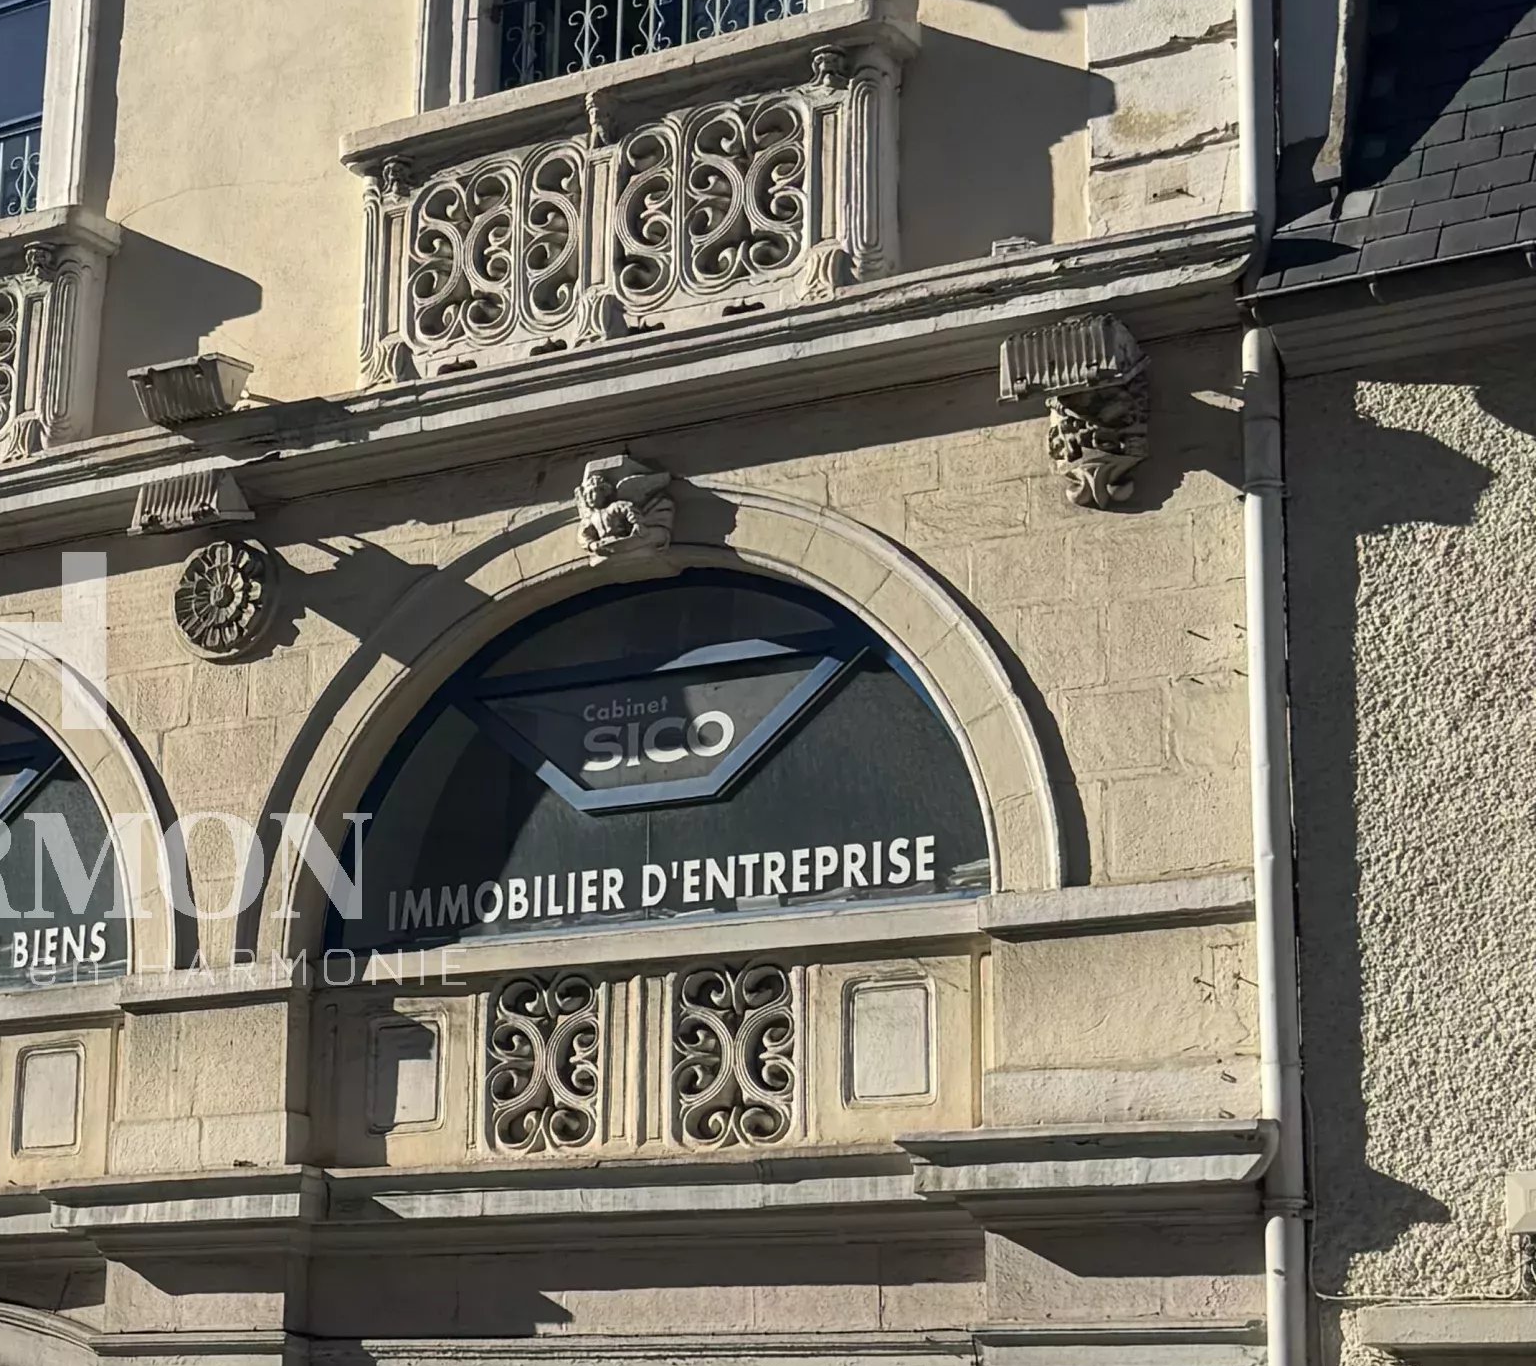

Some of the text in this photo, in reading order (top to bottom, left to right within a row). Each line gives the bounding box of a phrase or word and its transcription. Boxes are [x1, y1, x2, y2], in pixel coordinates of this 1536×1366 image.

[583, 697, 667, 723] Cabinet
[581, 709, 735, 772] SICO
[387, 835, 937, 932] IMMOBILIER D'ENTREPRISE
[12, 921, 109, 969] BIENS
